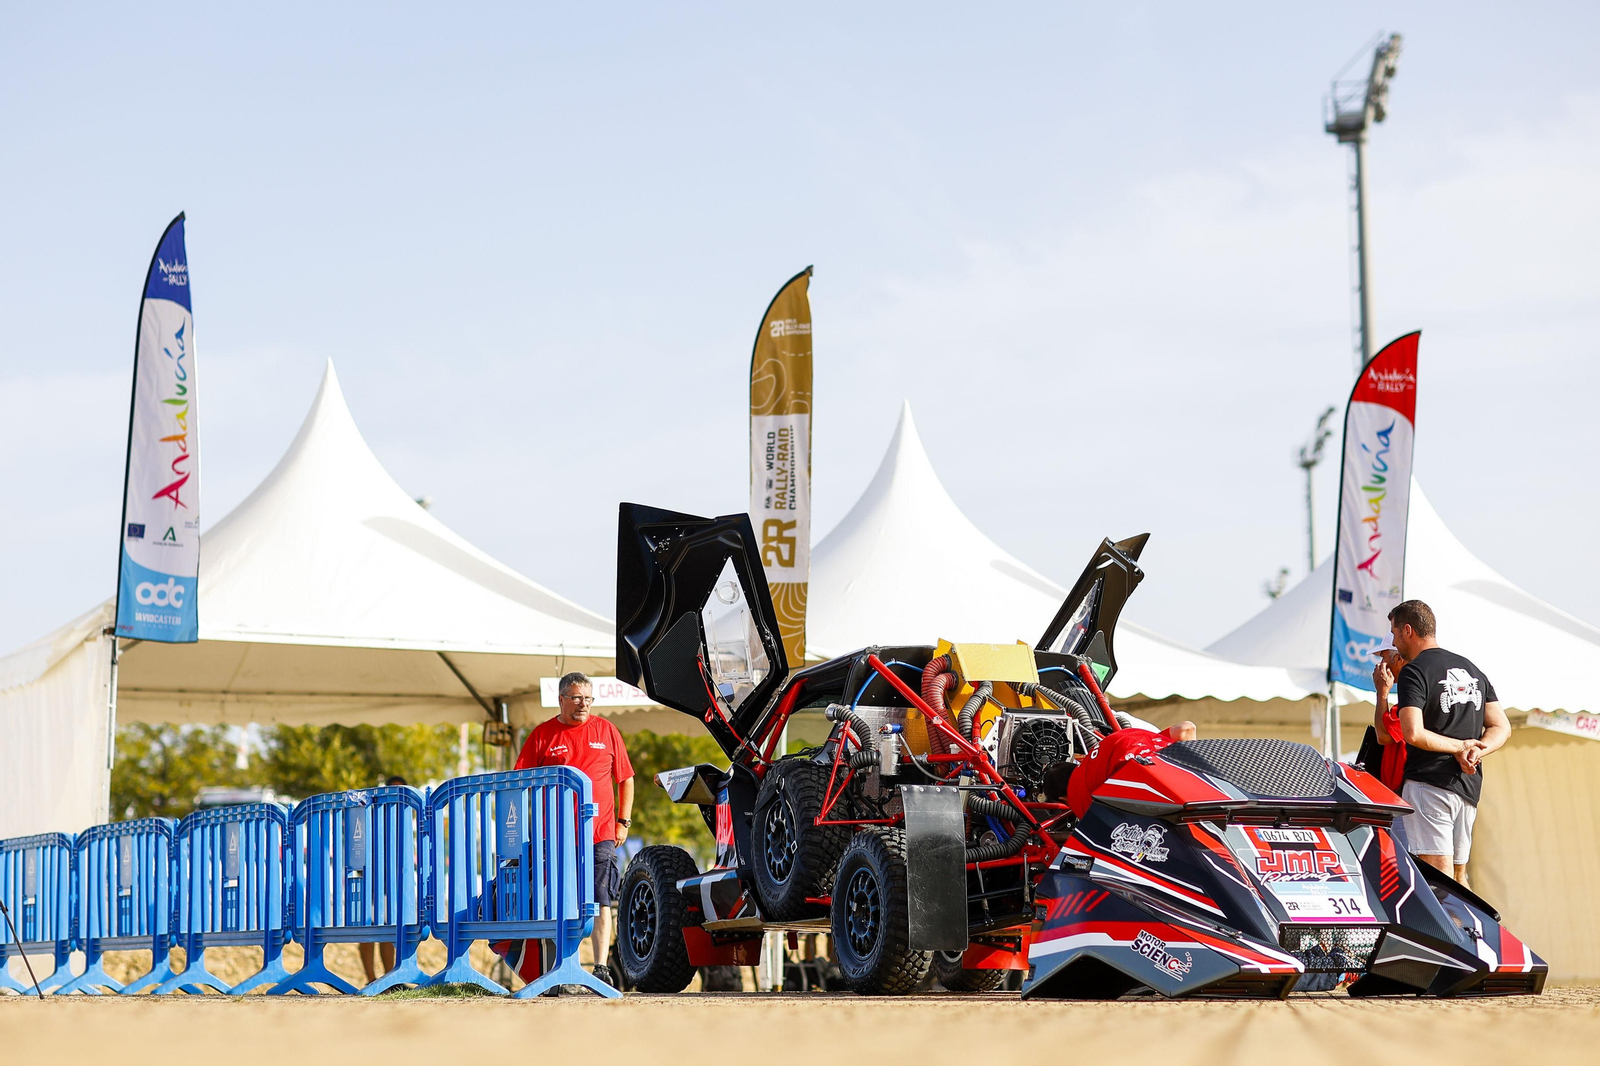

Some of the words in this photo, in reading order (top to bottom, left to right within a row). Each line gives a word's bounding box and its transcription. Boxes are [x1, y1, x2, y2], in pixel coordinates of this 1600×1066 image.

[152, 316, 191, 511] Andalucía
[765, 431, 776, 471] WORLD
[774, 427, 790, 510] RALLY-RAID
[788, 425, 797, 510] CHAMPIONSHIP
[1357, 418, 1396, 581] Andalucía
[599, 683, 624, 699] CAR
[1263, 830, 1290, 842] 0674
[1293, 831, 1315, 842] BZV
[1256, 850, 1340, 874] JMP
[1260, 871, 1361, 886] Racing
[1328, 897, 1362, 915] 314
[1138, 930, 1167, 950] MOTOR
